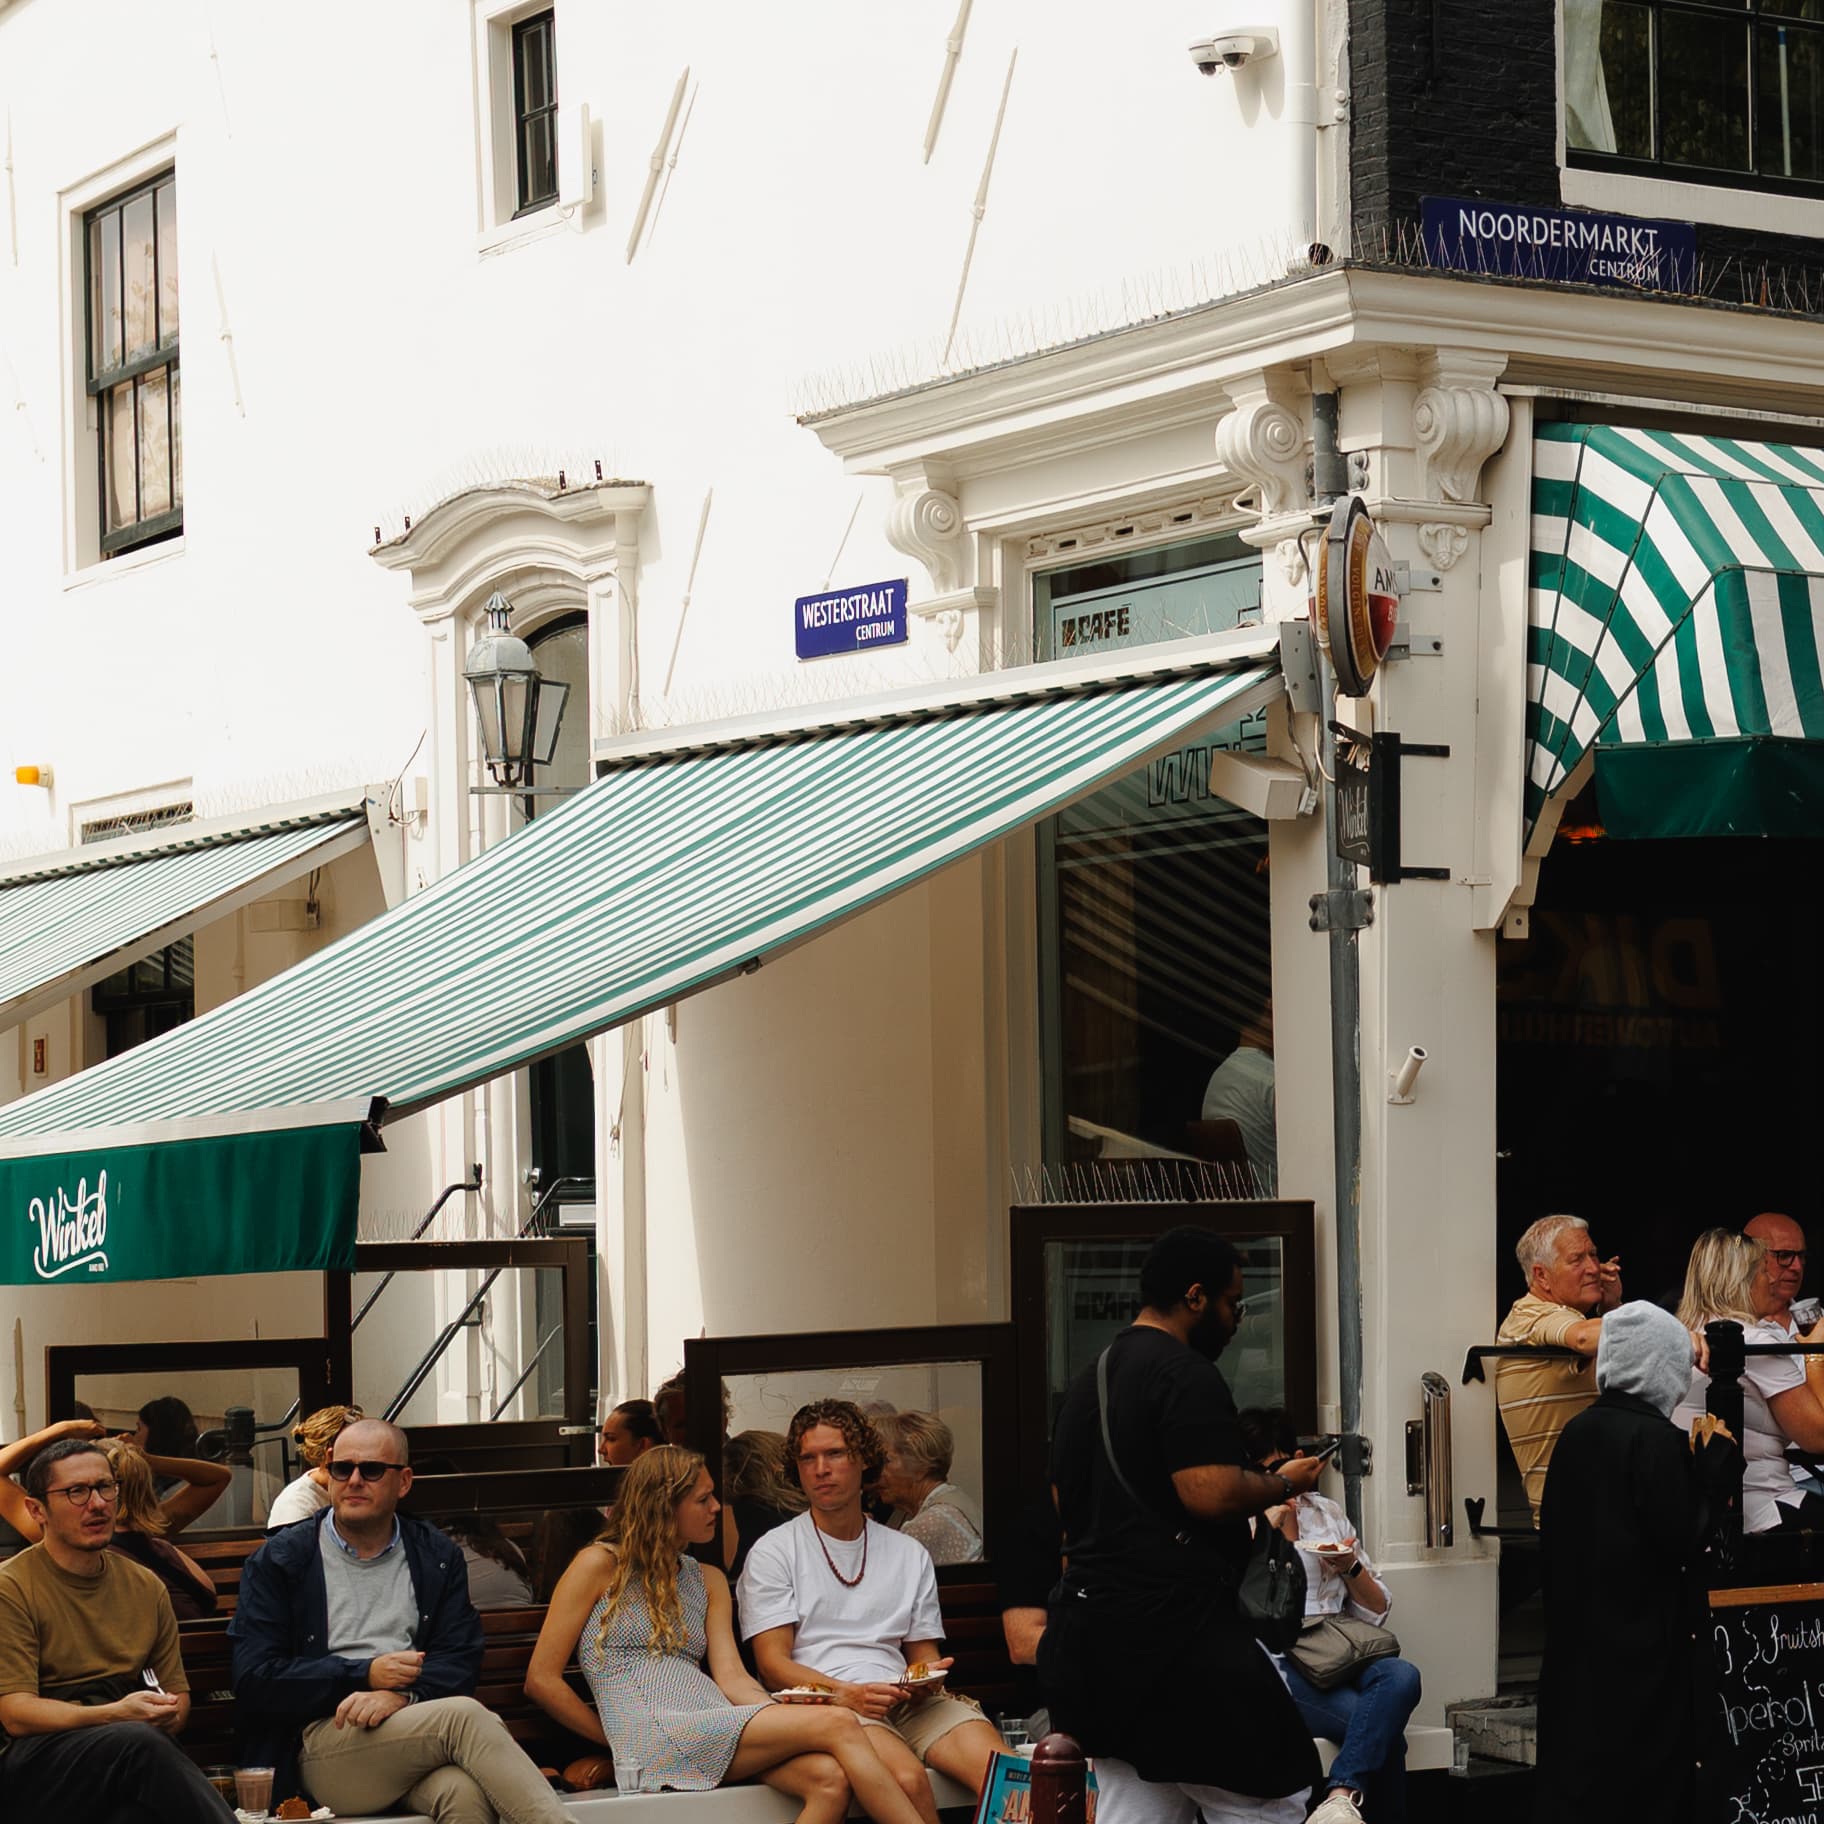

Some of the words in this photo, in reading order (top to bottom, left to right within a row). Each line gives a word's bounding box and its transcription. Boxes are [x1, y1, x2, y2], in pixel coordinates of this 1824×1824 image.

[1459, 208, 1658, 256] NOORDERMARKT
[1589, 258, 1660, 282] CENTRUM
[801, 587, 894, 631] WESTERSTRAAT
[854, 619, 895, 642] CENTRUM
[28, 1168, 108, 1269] Winkel
